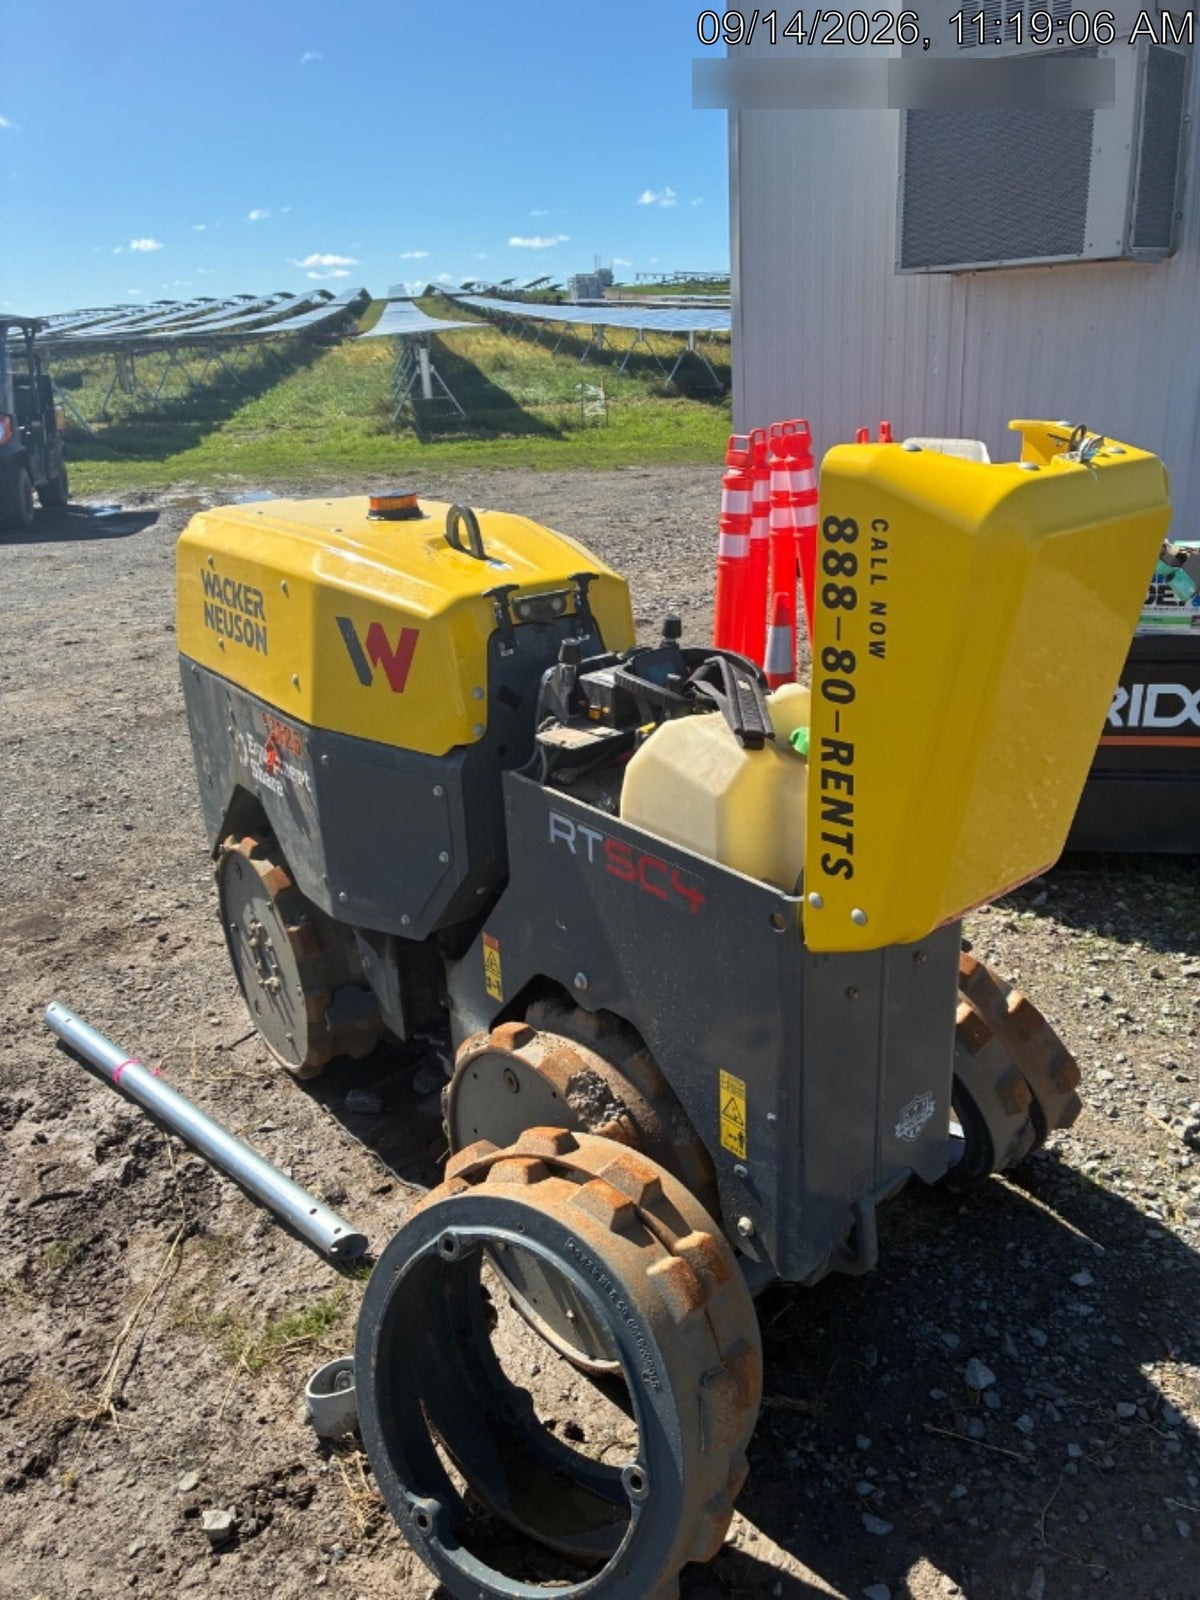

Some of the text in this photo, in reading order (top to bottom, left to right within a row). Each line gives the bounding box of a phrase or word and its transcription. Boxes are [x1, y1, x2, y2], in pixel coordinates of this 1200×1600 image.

[200, 567, 267, 622] WACKER
[868, 518, 889, 660] CALL NOW
[203, 601, 268, 656] NEUSON
[820, 515, 859, 881] 888-80-RENTS
[1107, 683, 1200, 727] RID
[246, 732, 312, 793] Eqment
